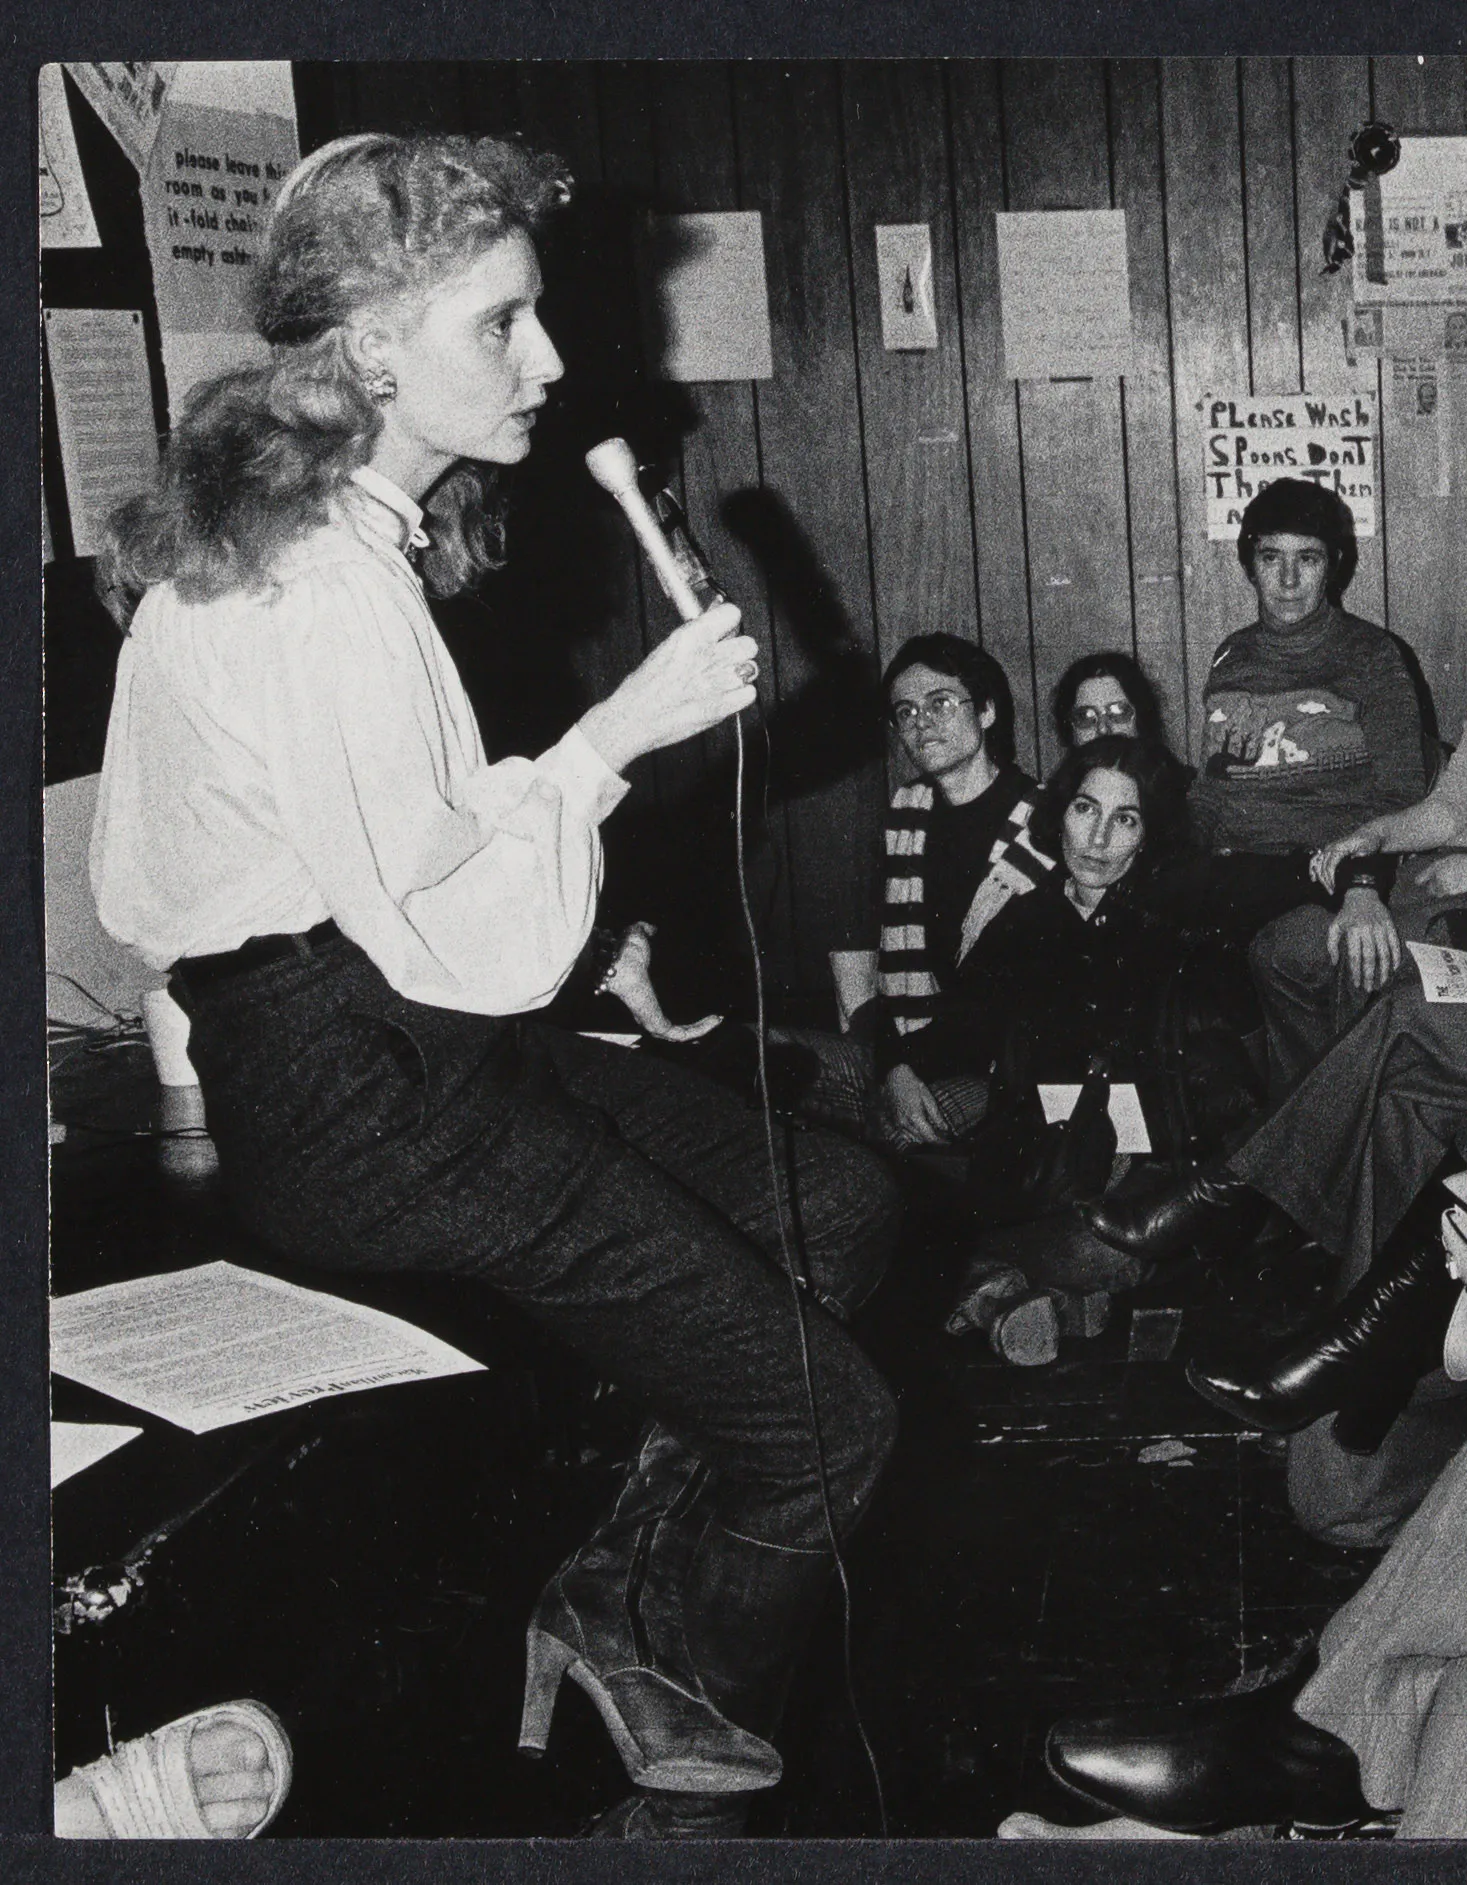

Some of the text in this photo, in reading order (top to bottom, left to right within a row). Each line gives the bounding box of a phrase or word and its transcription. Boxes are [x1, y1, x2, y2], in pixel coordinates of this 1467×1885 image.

[175, 147, 220, 172] please
[225, 152, 260, 178] leave
[164, 180, 203, 197] room
[211, 185, 227, 202] as
[233, 188, 259, 207] you
[167, 206, 180, 227] it
[172, 244, 215, 268] empty
